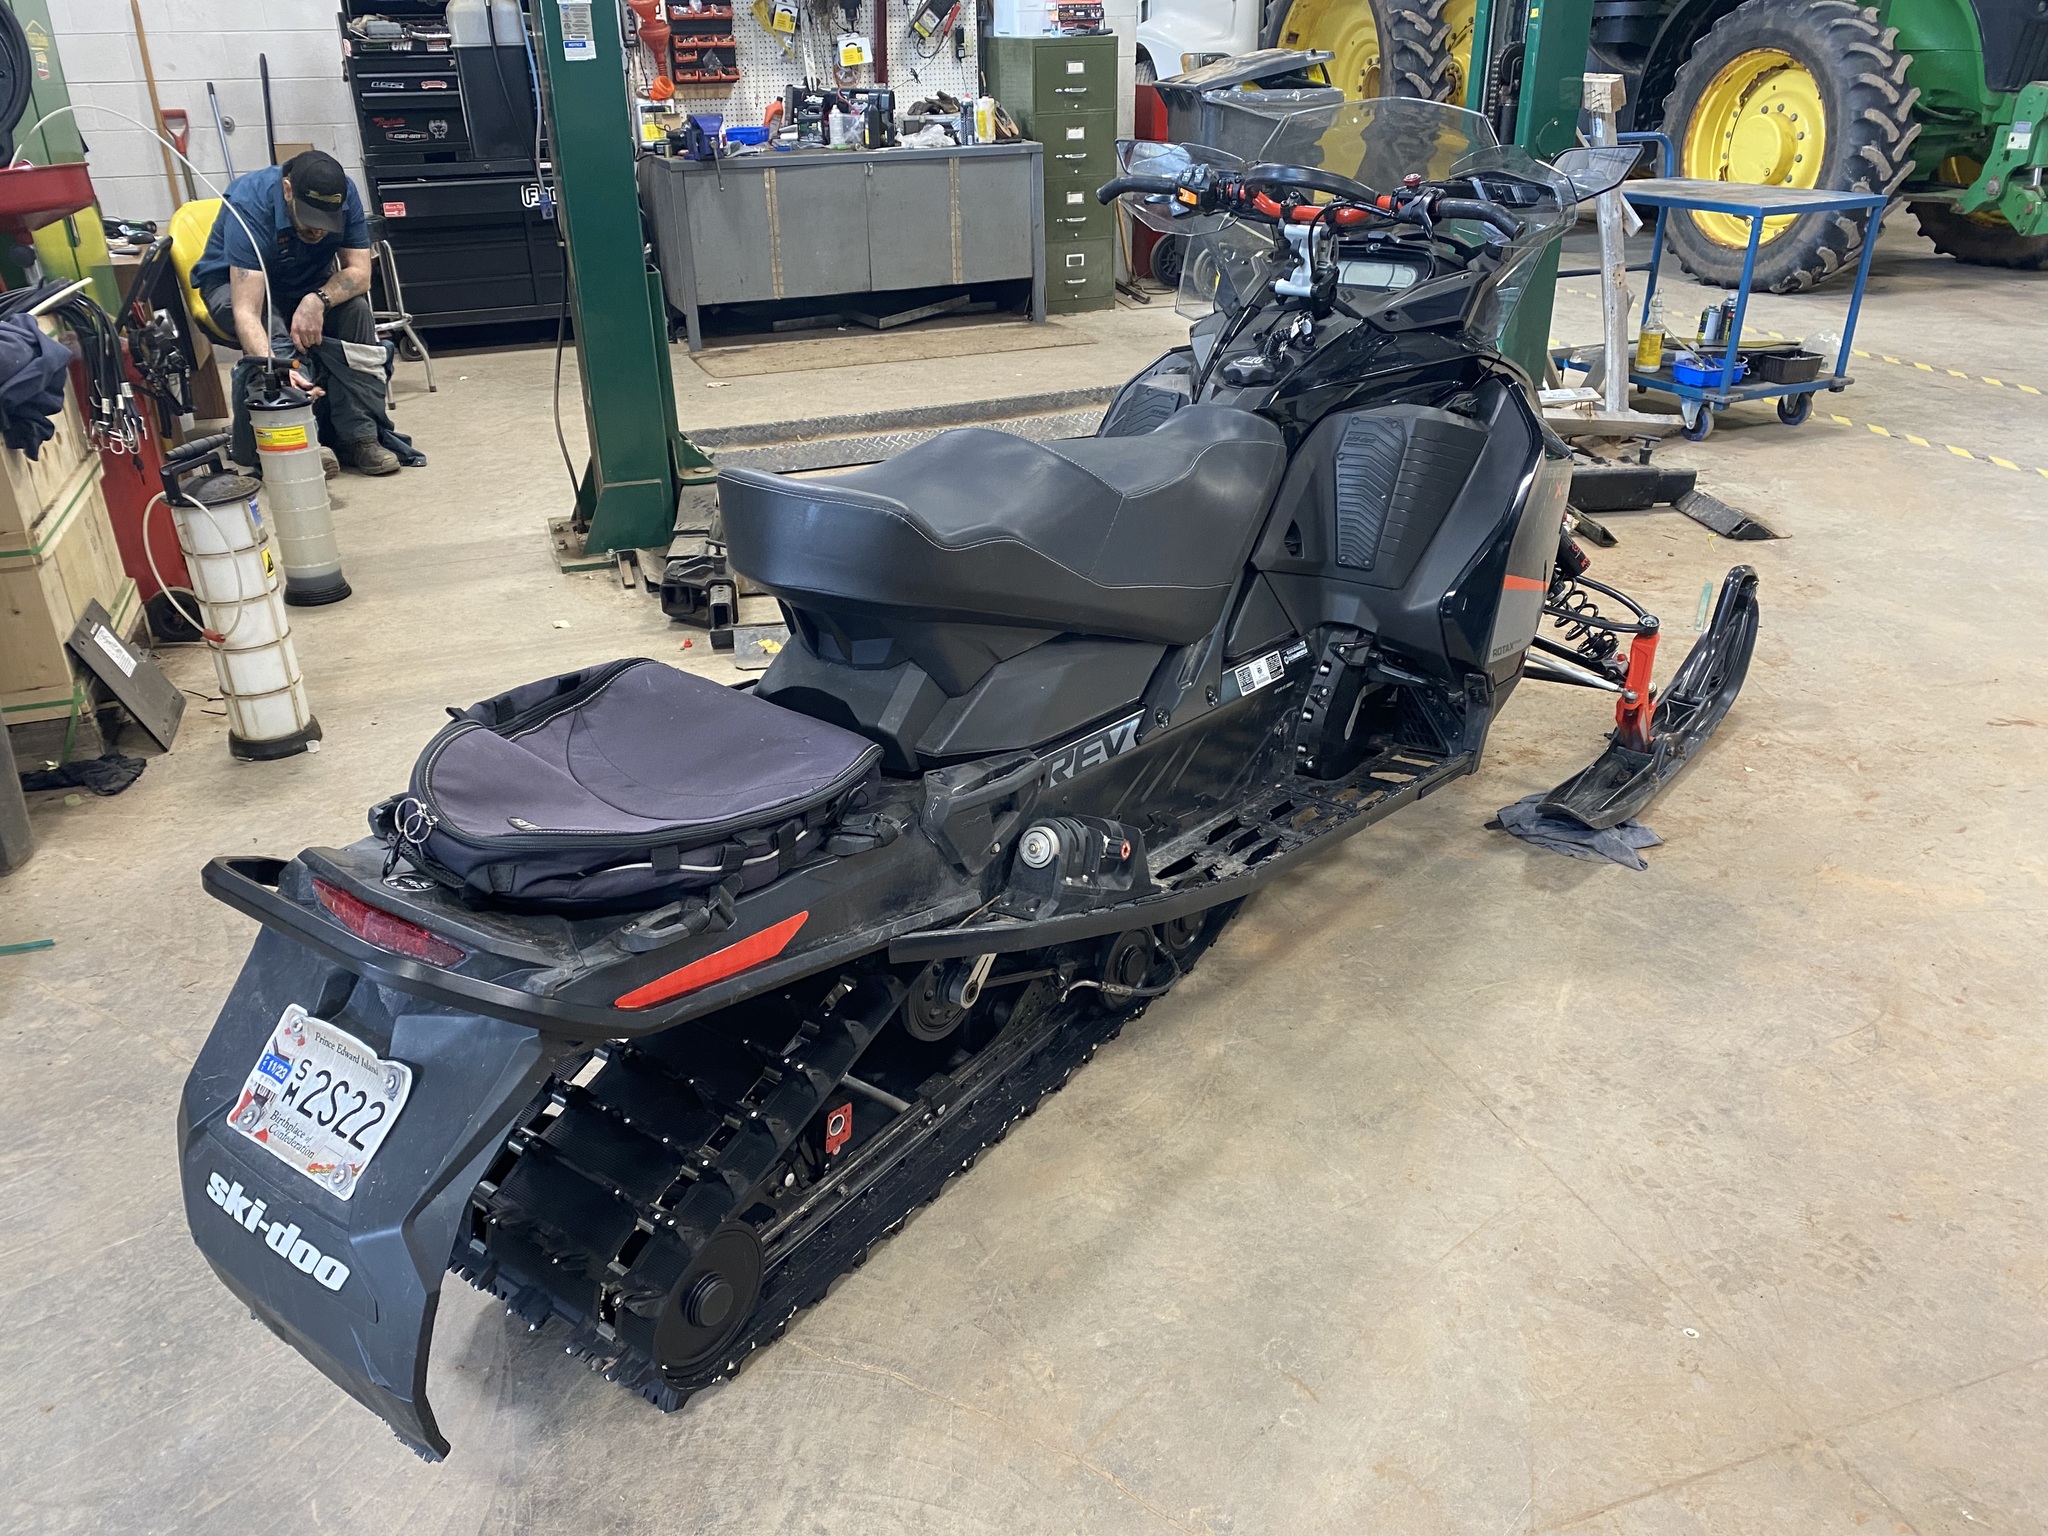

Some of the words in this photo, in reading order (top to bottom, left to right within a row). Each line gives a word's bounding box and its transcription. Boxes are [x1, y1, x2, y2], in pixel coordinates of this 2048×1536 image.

[1492, 642, 1514, 657] ROTAX
[1043, 724, 1132, 790] REV
[267, 1060, 288, 1080] 11/23
[315, 1032, 335, 1050] Prince
[336, 1043, 360, 1064] Edward
[361, 1057, 379, 1076] Island
[270, 1110, 306, 1138] Birthplace
[297, 1070, 386, 1151] 2S22
[268, 1124, 315, 1159] Confederation
[206, 1172, 350, 1291] ski-doo
